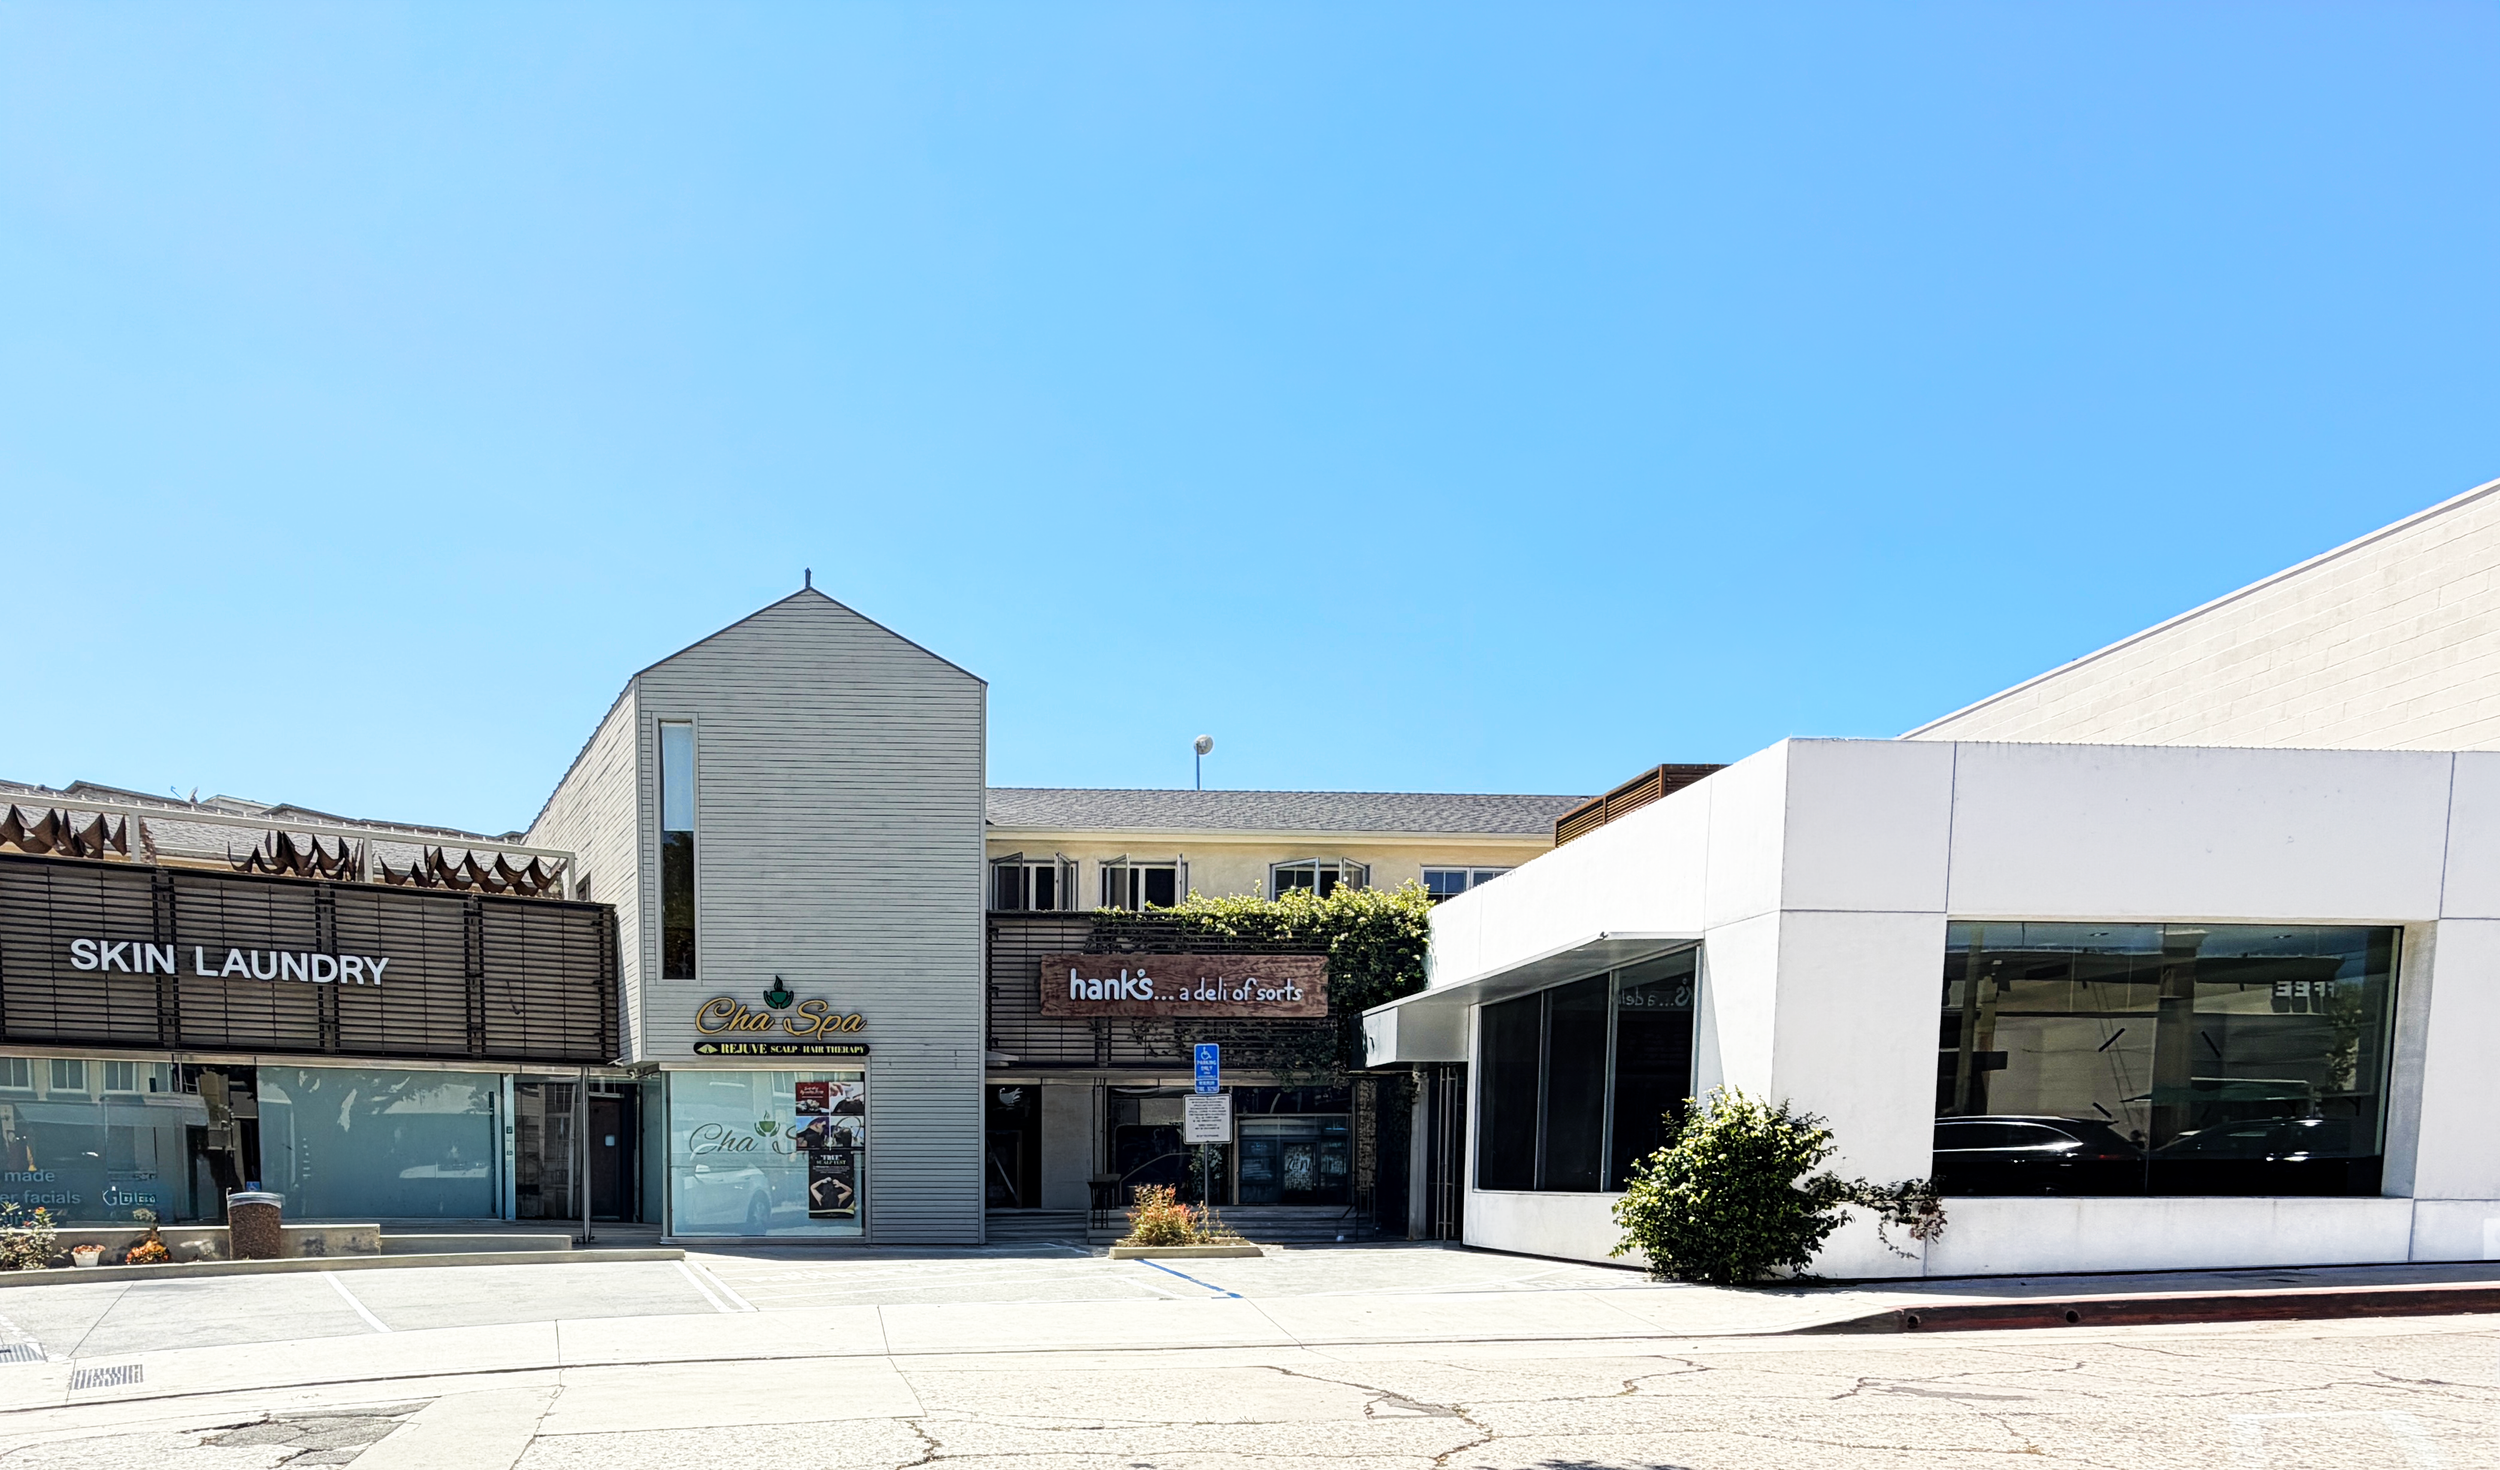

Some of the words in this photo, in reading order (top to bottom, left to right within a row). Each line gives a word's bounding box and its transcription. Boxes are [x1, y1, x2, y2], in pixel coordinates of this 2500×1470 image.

[70, 938, 175, 975] SKIN
[195, 945, 390, 986] LAUNDRY
[1179, 986, 1190, 1001] a
[1193, 976, 1227, 1001] deli
[1232, 977, 1257, 1001] of
[1256, 977, 1303, 1001] sorts
[695, 996, 776, 1035] Cha
[782, 999, 868, 1042] Spa
[721, 1043, 768, 1054] REJUVE
[770, 1045, 798, 1054] SCALP
[803, 1045, 825, 1054] HAIR
[826, 1045, 865, 1054] THERAPY
[689, 1122, 759, 1155] Cha
[4, 1169, 55, 1182] made
[24, 1190, 81, 1204] facials
